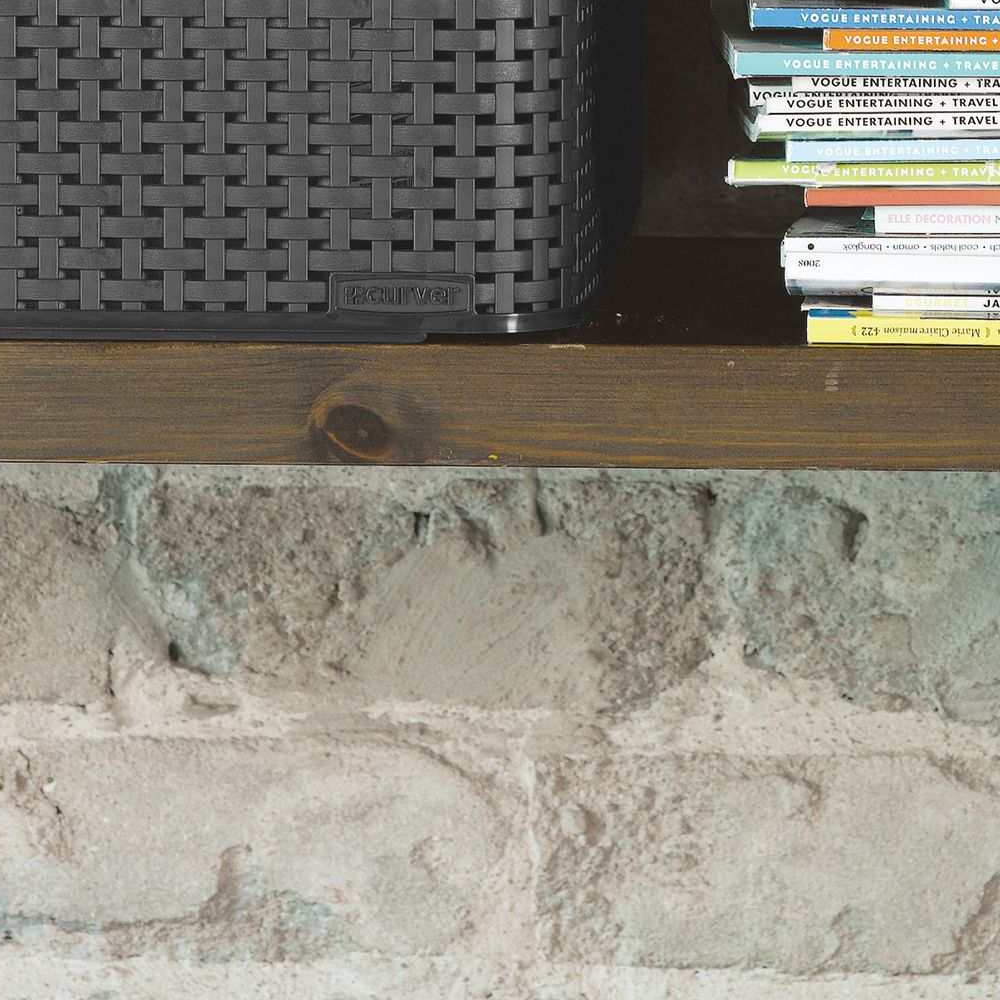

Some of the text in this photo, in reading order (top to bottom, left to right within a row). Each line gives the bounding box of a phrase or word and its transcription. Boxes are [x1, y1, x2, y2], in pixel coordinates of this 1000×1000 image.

[801, 13, 847, 23] VOGUE
[854, 14, 955, 24] ENTERTAINING
[974, 15, 1000, 24] TRA
[844, 35, 888, 45] VOGUE
[893, 36, 987, 45] ENTERTAINING
[783, 59, 829, 69] VOGUE
[836, 60, 937, 70] ENTERTAINING
[955, 61, 999, 70] TRAVE
[811, 78, 857, 87] VOGUE
[863, 78, 958, 88] ENTERTAINING
[976, 78, 1000, 88] TRA
[787, 99, 832, 108] VOGUE
[839, 98, 933, 108] ENTERTAINING
[952, 98, 998, 107] TRAVEL
[786, 118, 832, 126] VOGUE
[838, 116, 933, 126] ENTERTAINING
[952, 116, 998, 125] TRAVEL
[834, 167, 935, 177] ENTERTAINING
[888, 214, 911, 224] ELLE
[915, 213, 991, 224] DECORATION
[843, 242, 882, 251] bangkok
[366, 286, 460, 306] curver
[861, 326, 980, 338] Marie Claire maison 422
